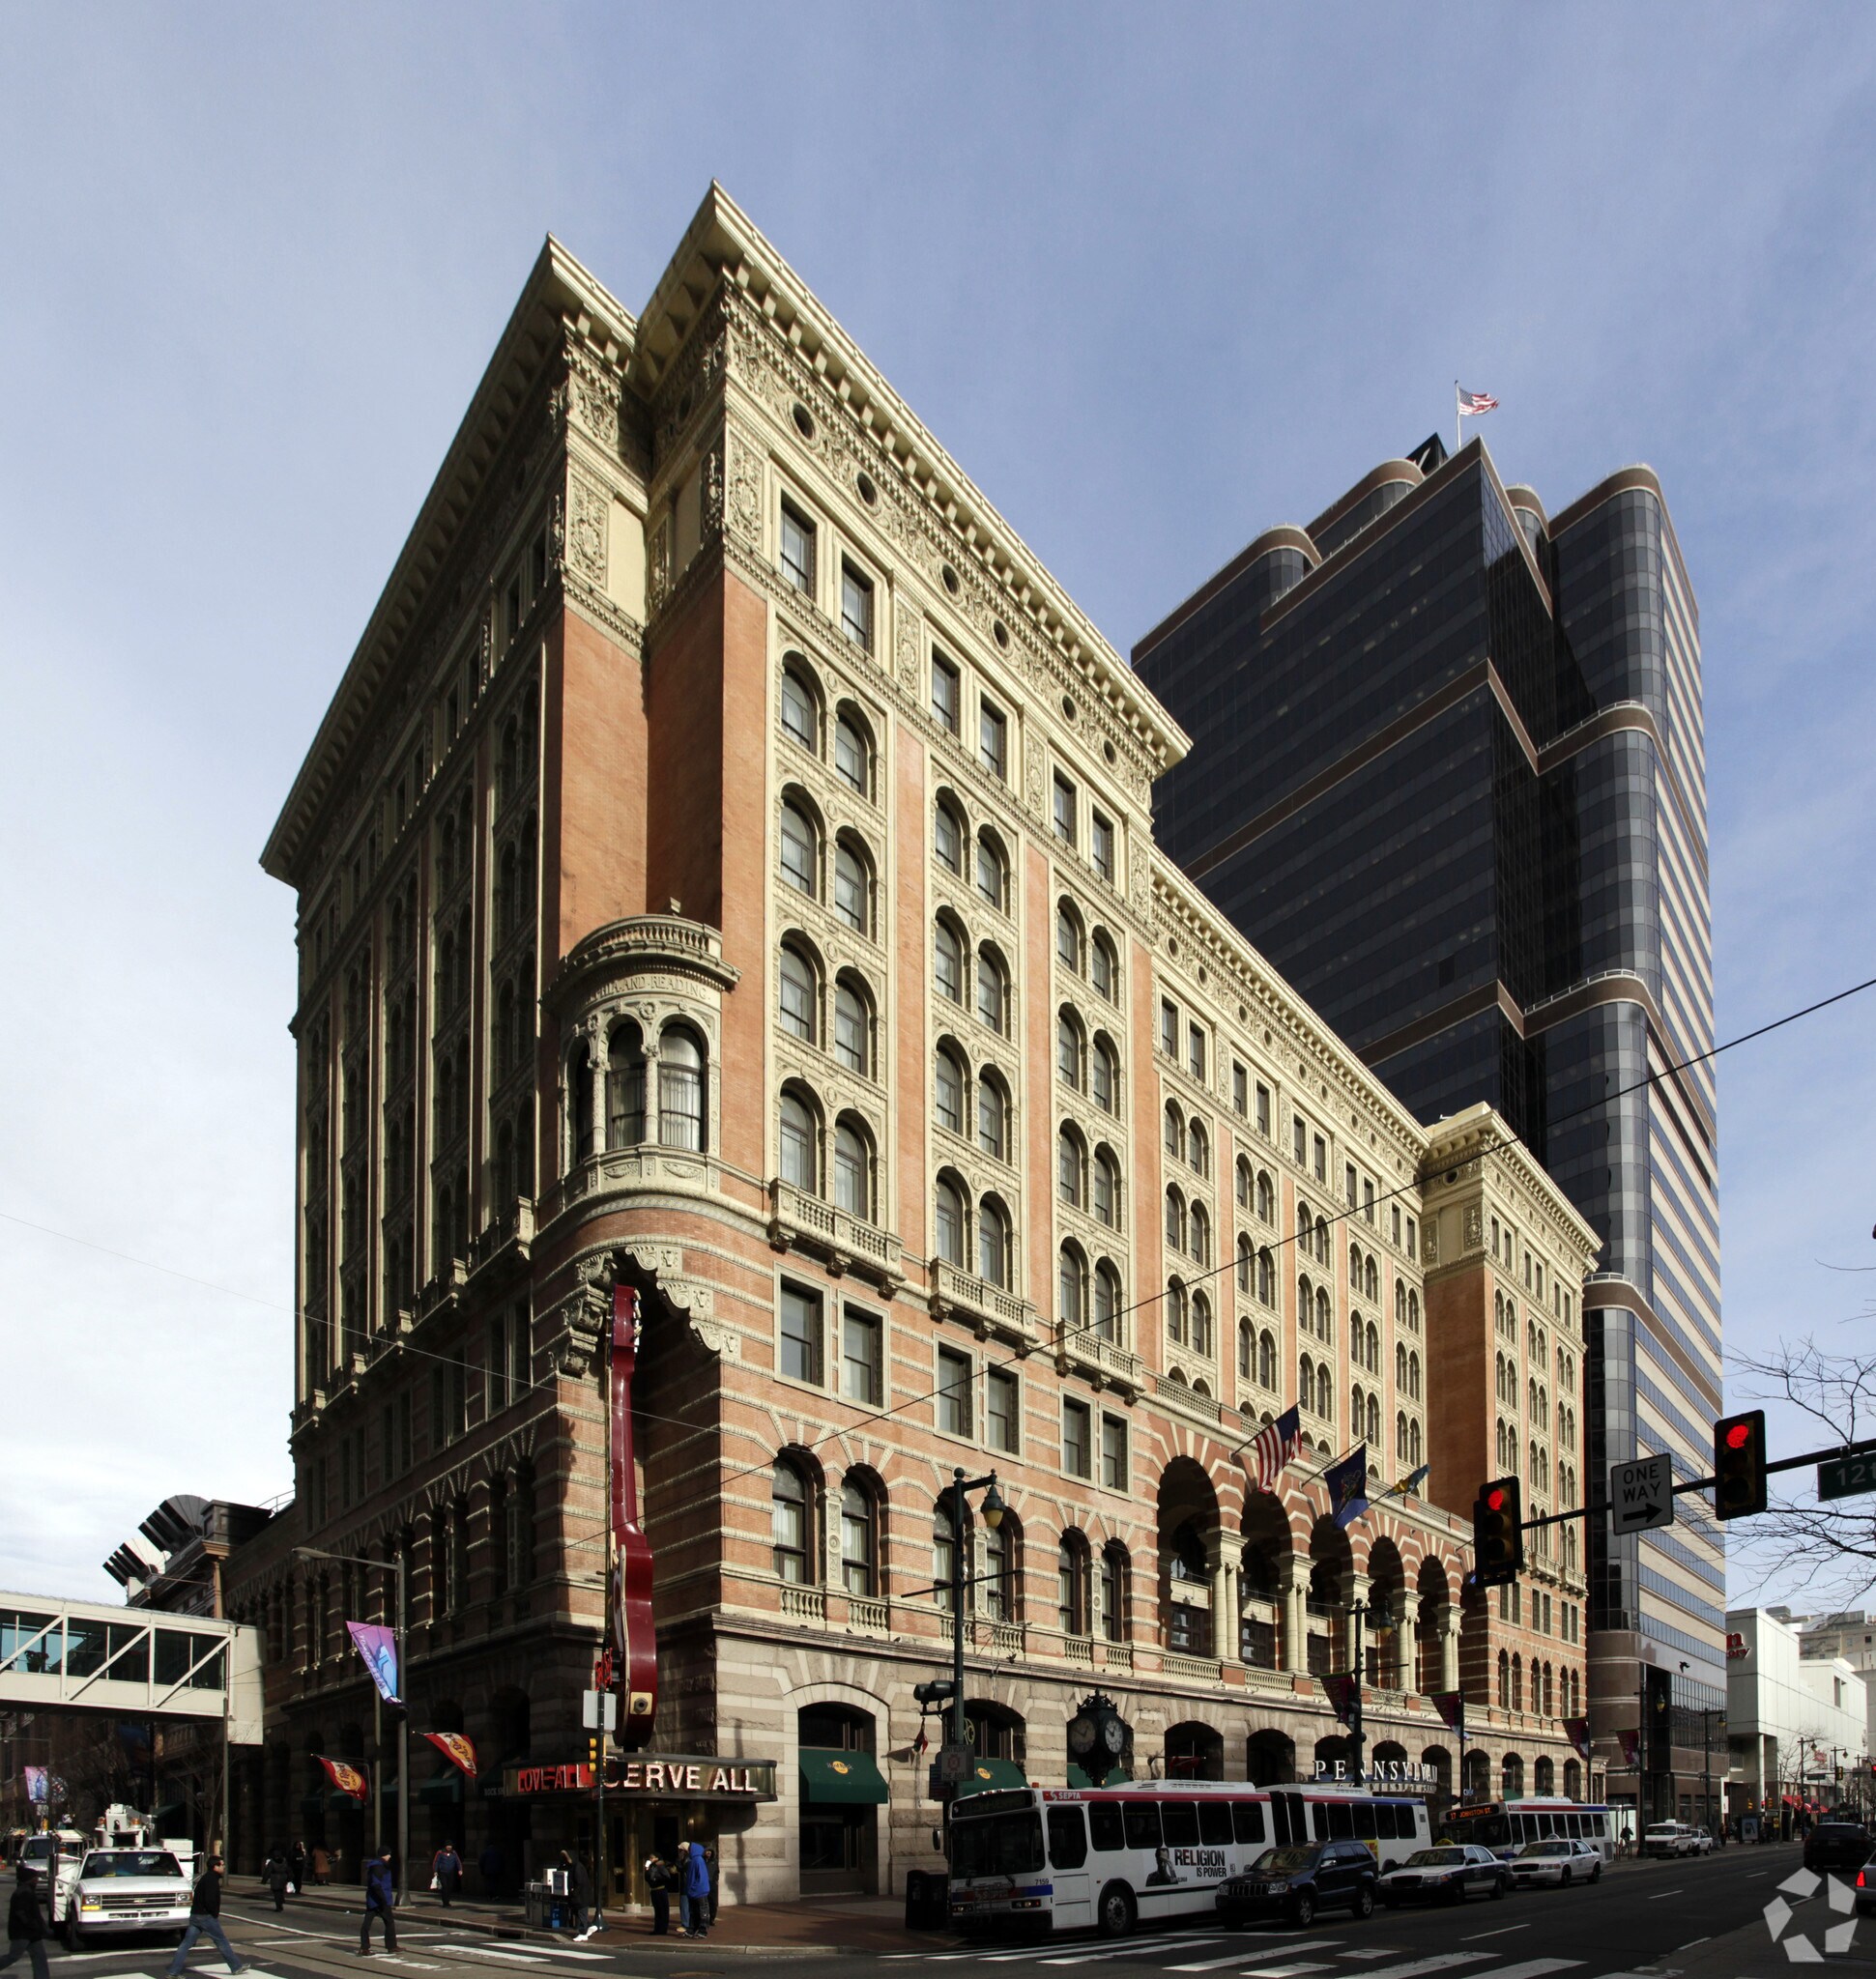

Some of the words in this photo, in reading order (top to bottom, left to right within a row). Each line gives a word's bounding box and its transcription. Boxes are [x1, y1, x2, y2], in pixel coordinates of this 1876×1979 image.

[1624, 1463, 1660, 1484] ONE
[1623, 1480, 1661, 1504] WAY
[603, 1764, 701, 1790] ERVE
[711, 1767, 758, 1792] ALL
[1058, 1792, 1081, 1800] SEPTA
[1459, 1809, 1484, 1819] JOHNSTON
[1174, 1849, 1226, 1867] RELIGION
[1197, 1867, 1202, 1878] IS
[1203, 1867, 1227, 1878] POWER
